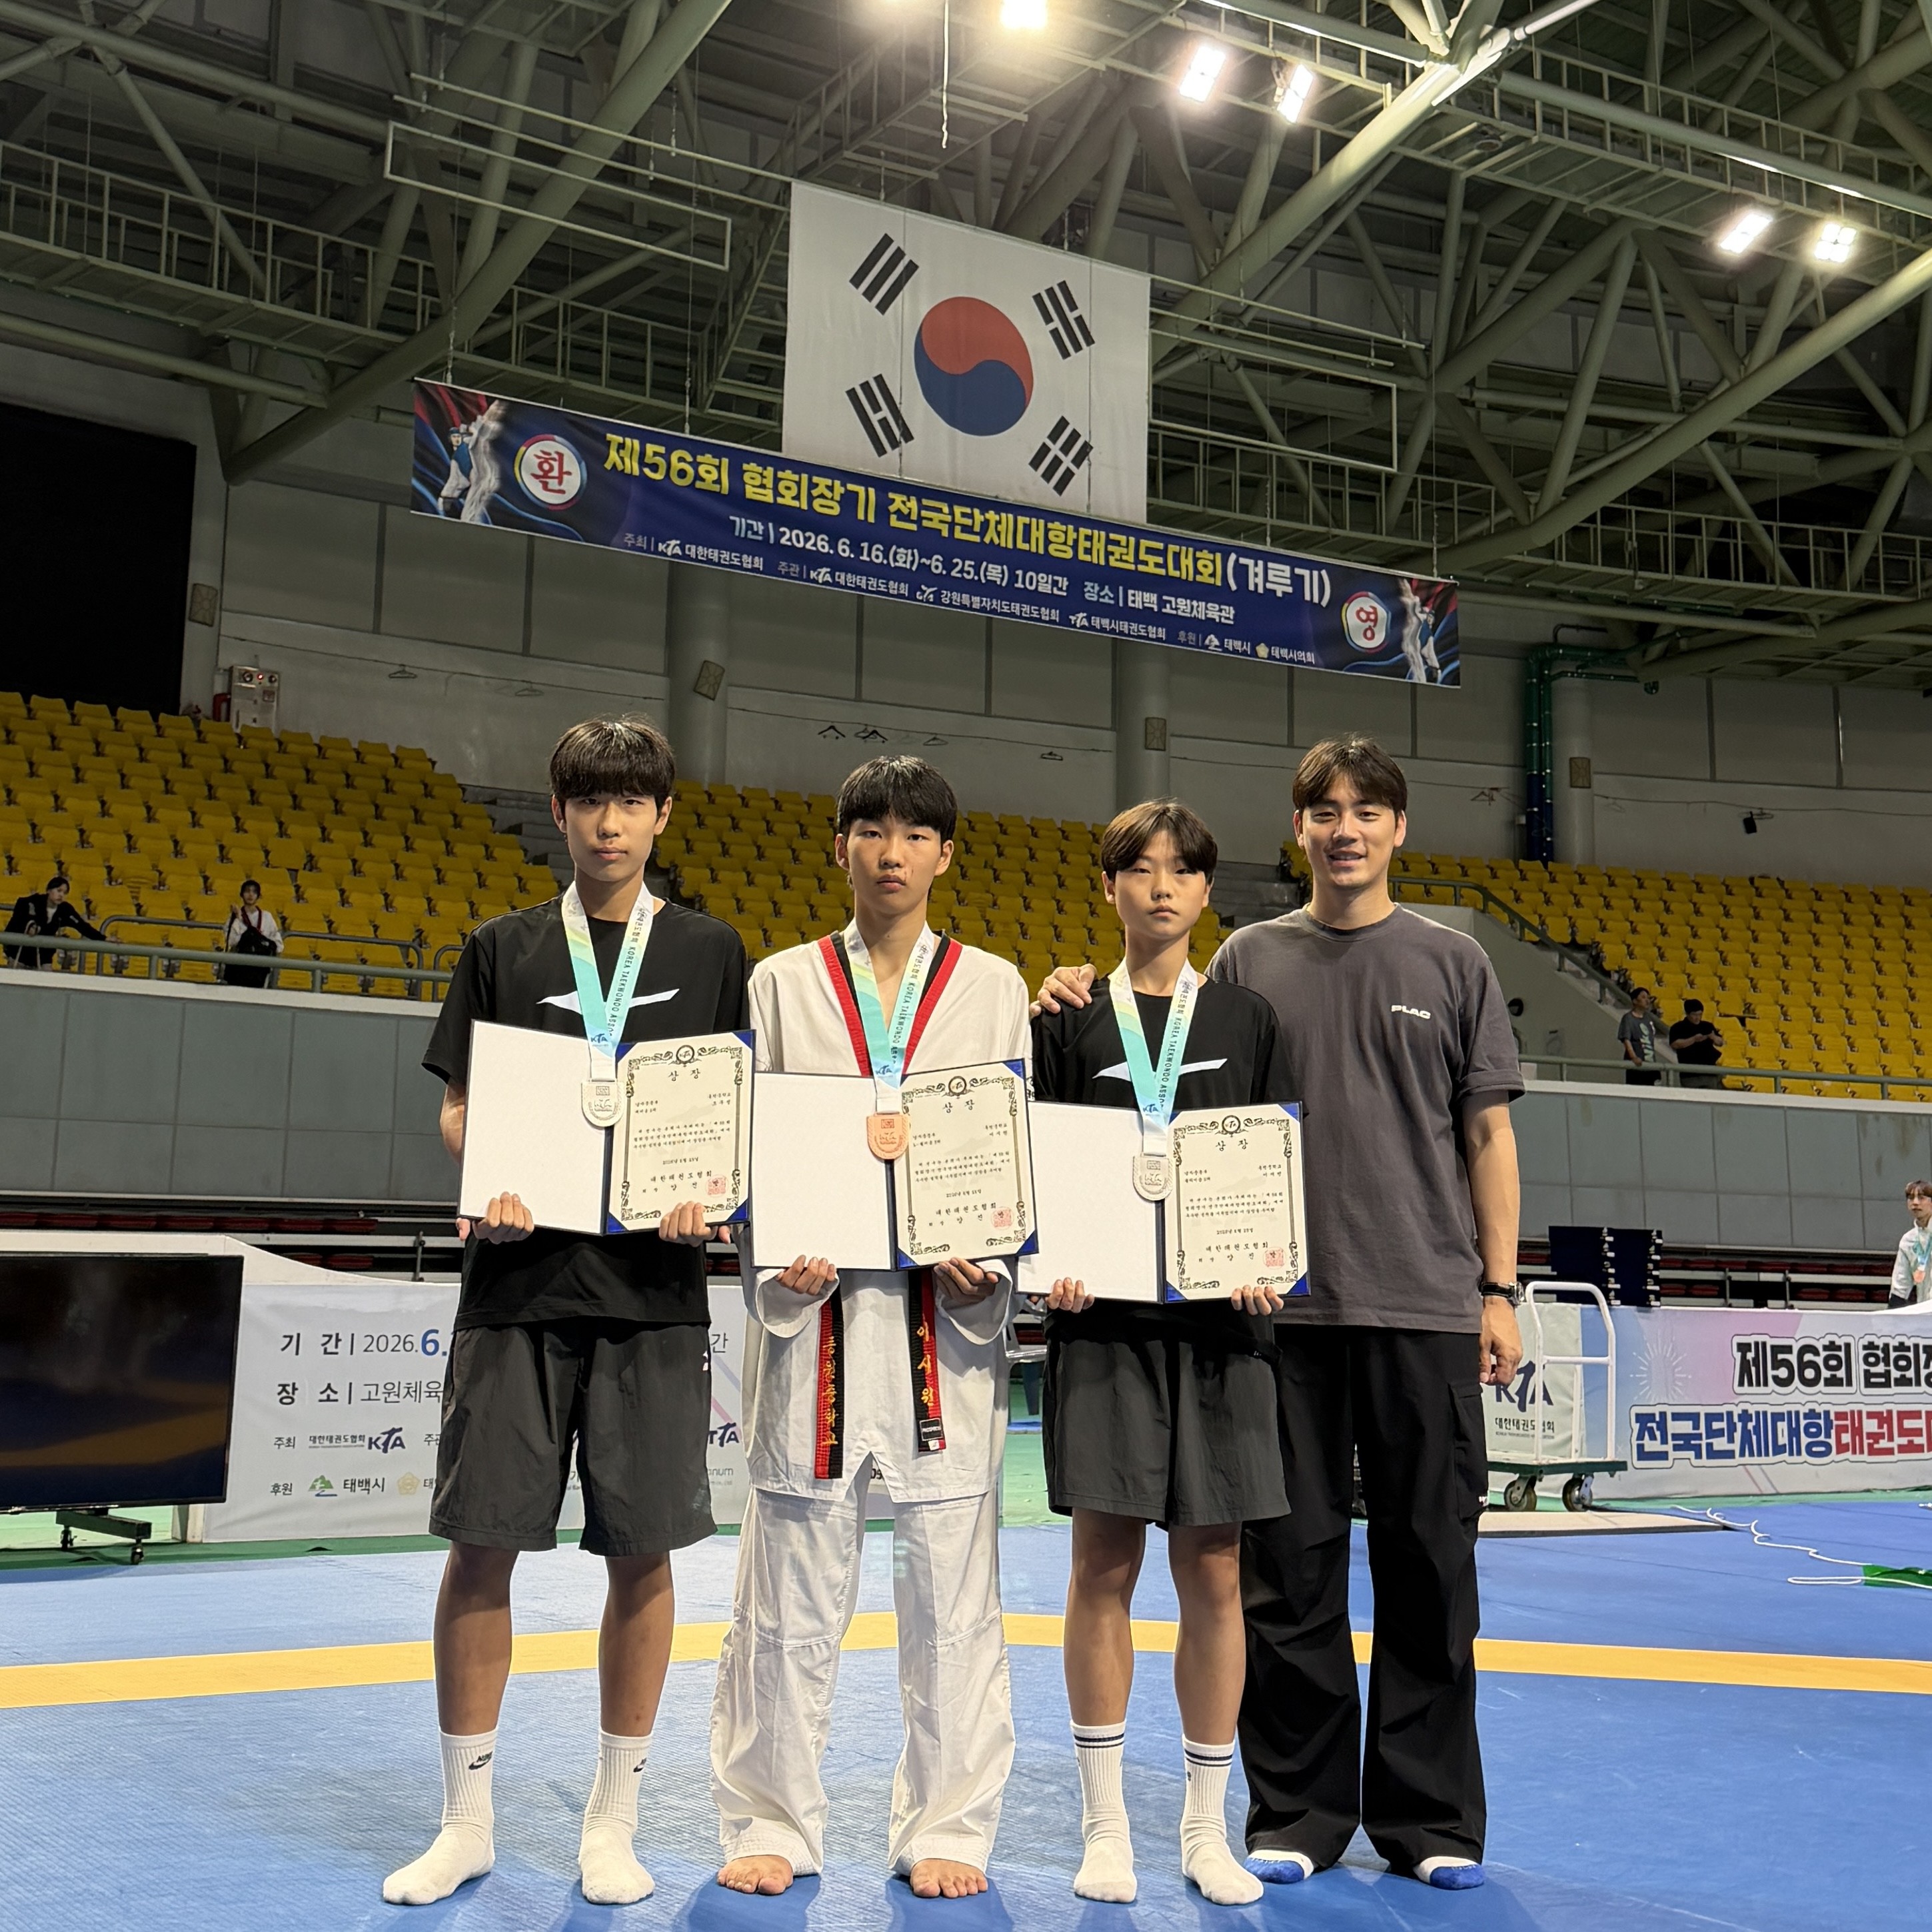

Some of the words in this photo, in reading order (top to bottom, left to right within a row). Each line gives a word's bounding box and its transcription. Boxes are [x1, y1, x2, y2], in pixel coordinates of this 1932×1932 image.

[530, 451, 571, 495] 환
[604, 433, 729, 494] 제56회
[742, 463, 876, 523] 협회장기
[729, 516, 764, 540] 기간
[1014, 570, 1068, 596] 10일간
[1084, 581, 1114, 604] 장소
[1128, 589, 1158, 612] 태백
[1162, 595, 1235, 624] 고원체육관
[624, 533, 646, 550] 주최
[658, 539, 682, 556] KTA
[685, 544, 763, 570] 대한태권도협회
[778, 561, 800, 576] 주관
[810, 567, 832, 583] KTA
[835, 571, 908, 596] 대한태권도협회
[940, 590, 1060, 622] 강원특별자치도태권도협회
[1091, 616, 1166, 640] 태백시태권도협회
[1178, 630, 1196, 645] 후원
[1224, 638, 1250, 655] 태백시
[1271, 646, 1315, 665] 태백시의회
[1355, 606, 1379, 641] 영
[612, 971, 629, 1011] TAEKWONDO
[1391, 1005, 1431, 1019] PLAC
[590, 1034, 608, 1043] KTA
[1162, 1040, 1178, 1082] TAEKWONDO
[363, 1329, 455, 1356] 2026.6.
[1735, 1341, 1853, 1388] 제56회
[361, 1380, 443, 1404] 고원체육
[273, 1436, 296, 1449] 주최
[309, 1434, 366, 1444] 대한태권도협회
[368, 1427, 406, 1453] KTA
[270, 1482, 293, 1496] 후원
[343, 1477, 385, 1494] 태백시
[423, 1478, 437, 1490] 태
